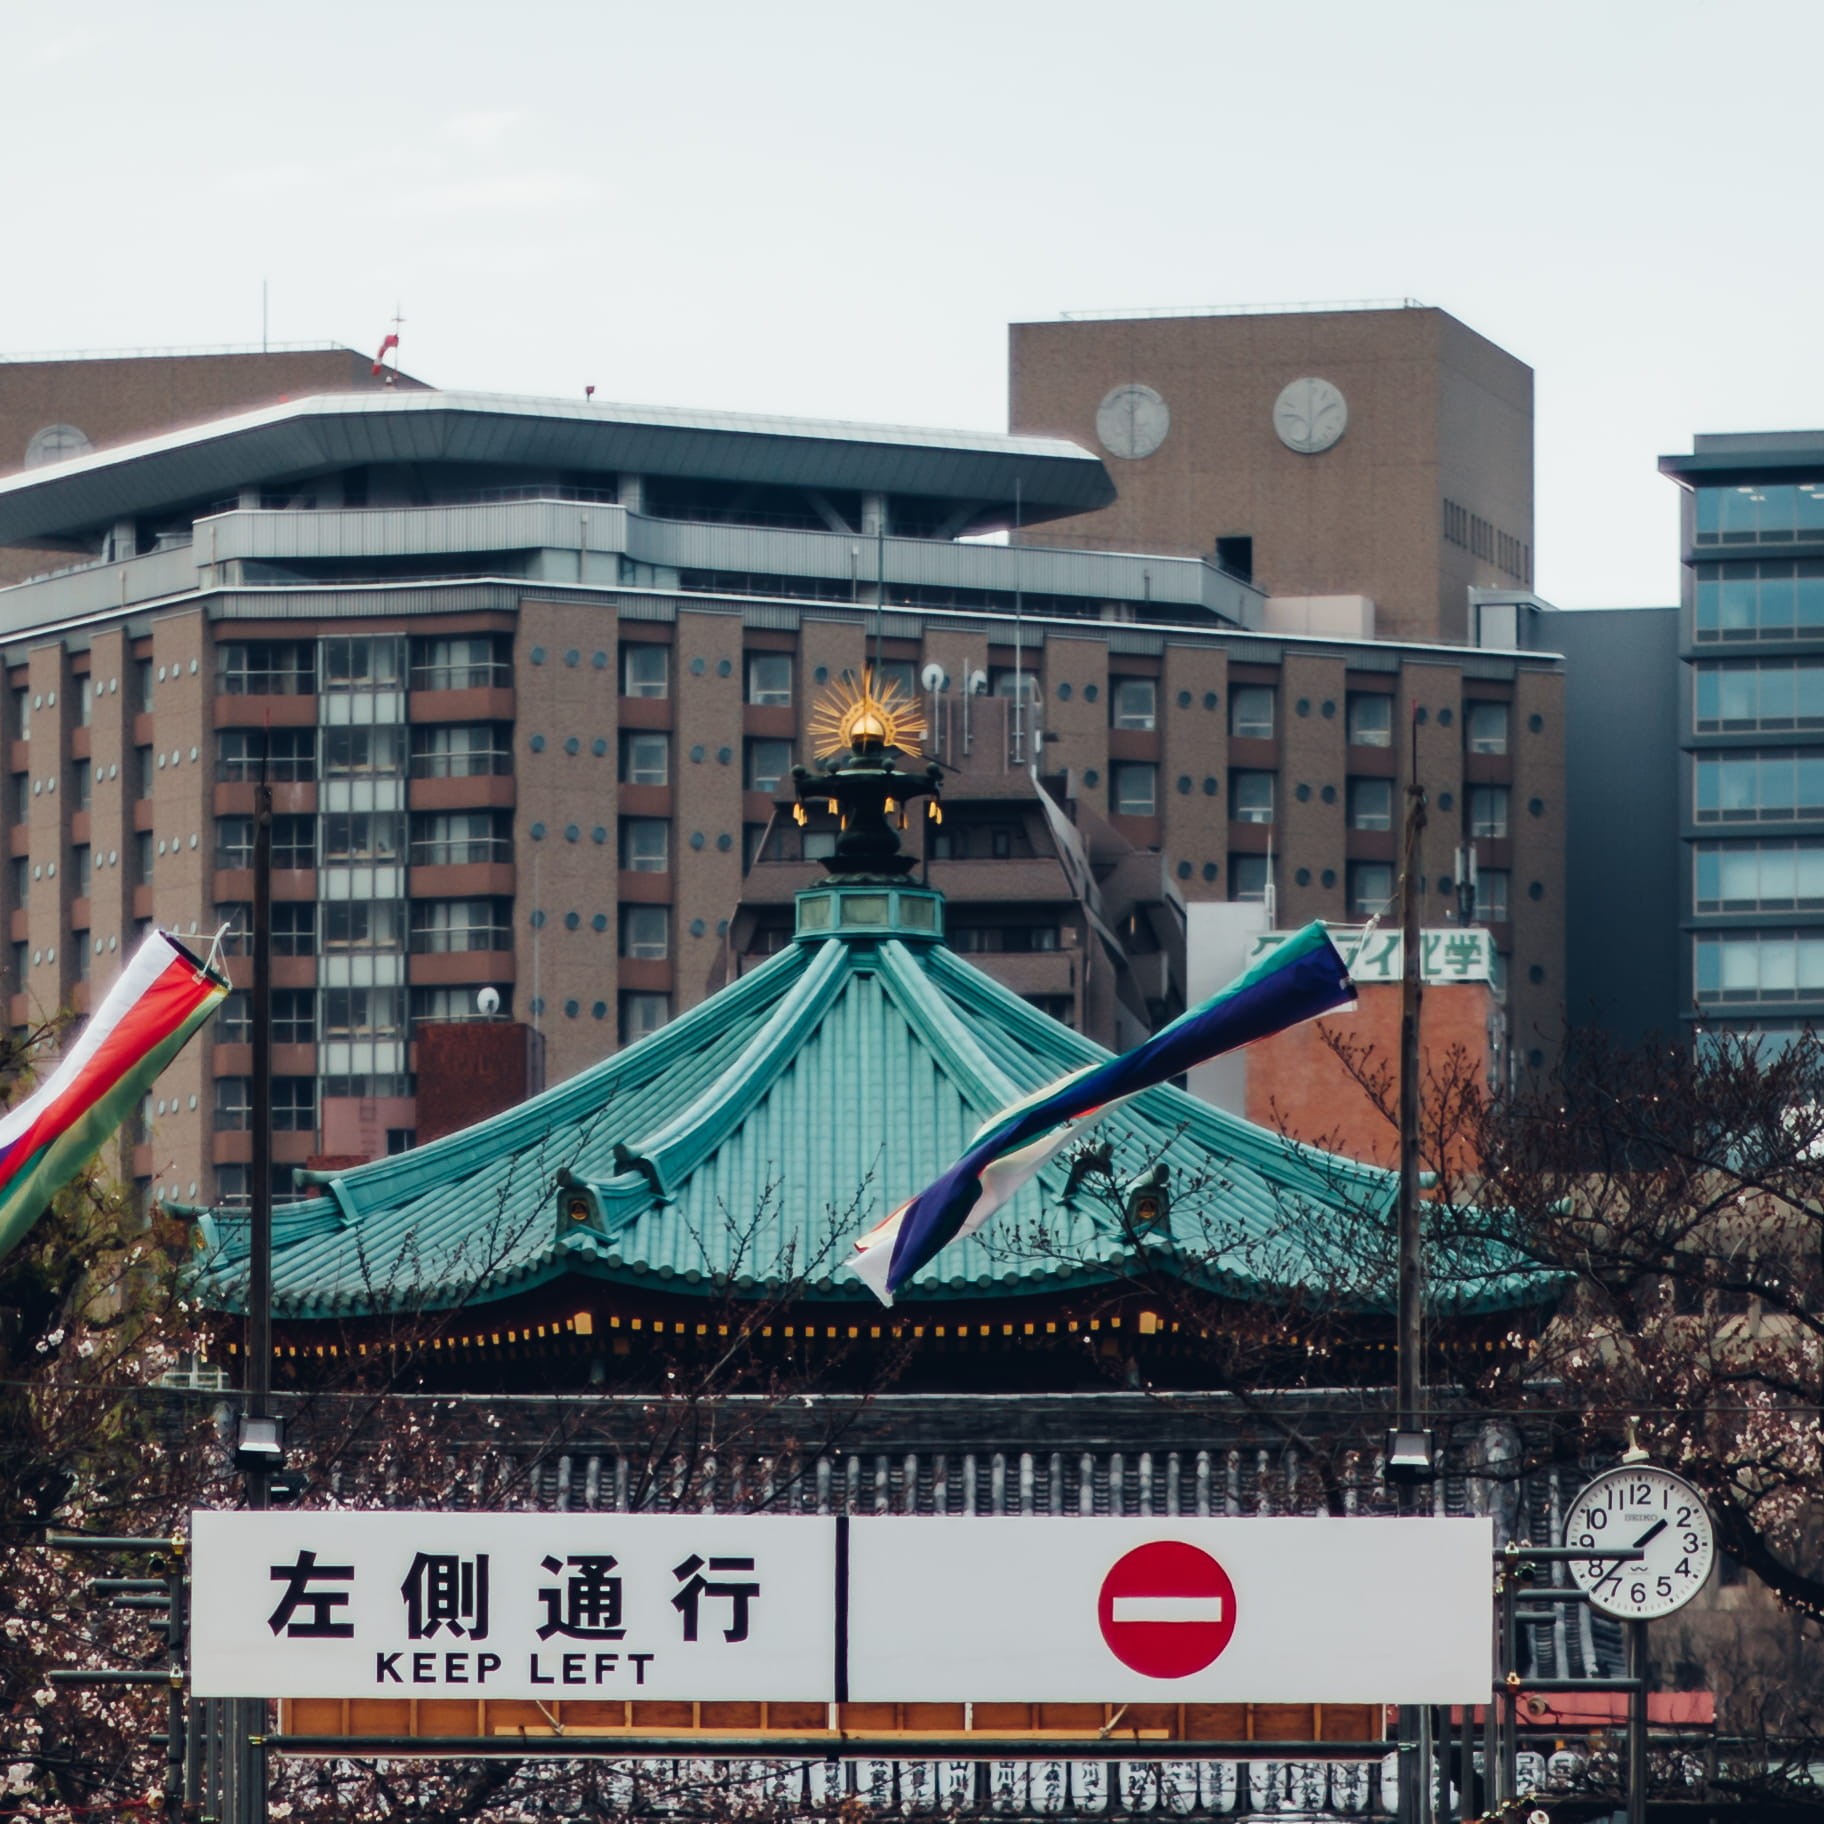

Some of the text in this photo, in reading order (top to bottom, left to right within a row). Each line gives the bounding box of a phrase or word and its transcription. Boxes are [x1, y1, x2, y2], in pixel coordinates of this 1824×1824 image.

[1608, 1490, 1624, 1510] 11
[1630, 1484, 1651, 1504] 12
[1664, 1490, 1668, 1510] 1
[1586, 1509, 1607, 1529] 10
[1677, 1507, 1691, 1527] 2
[1580, 1534, 1594, 1548] 9
[1683, 1533, 1698, 1553] 3
[1589, 1560, 1603, 1578] 8
[1675, 1558, 1690, 1577] 4
[267, 1550, 761, 1643] 左側通行
[1608, 1578, 1622, 1597] 7
[1631, 1583, 1645, 1603] 6
[1657, 1577, 1672, 1596] 5
[376, 1653, 656, 1684] KEEP LEFT
